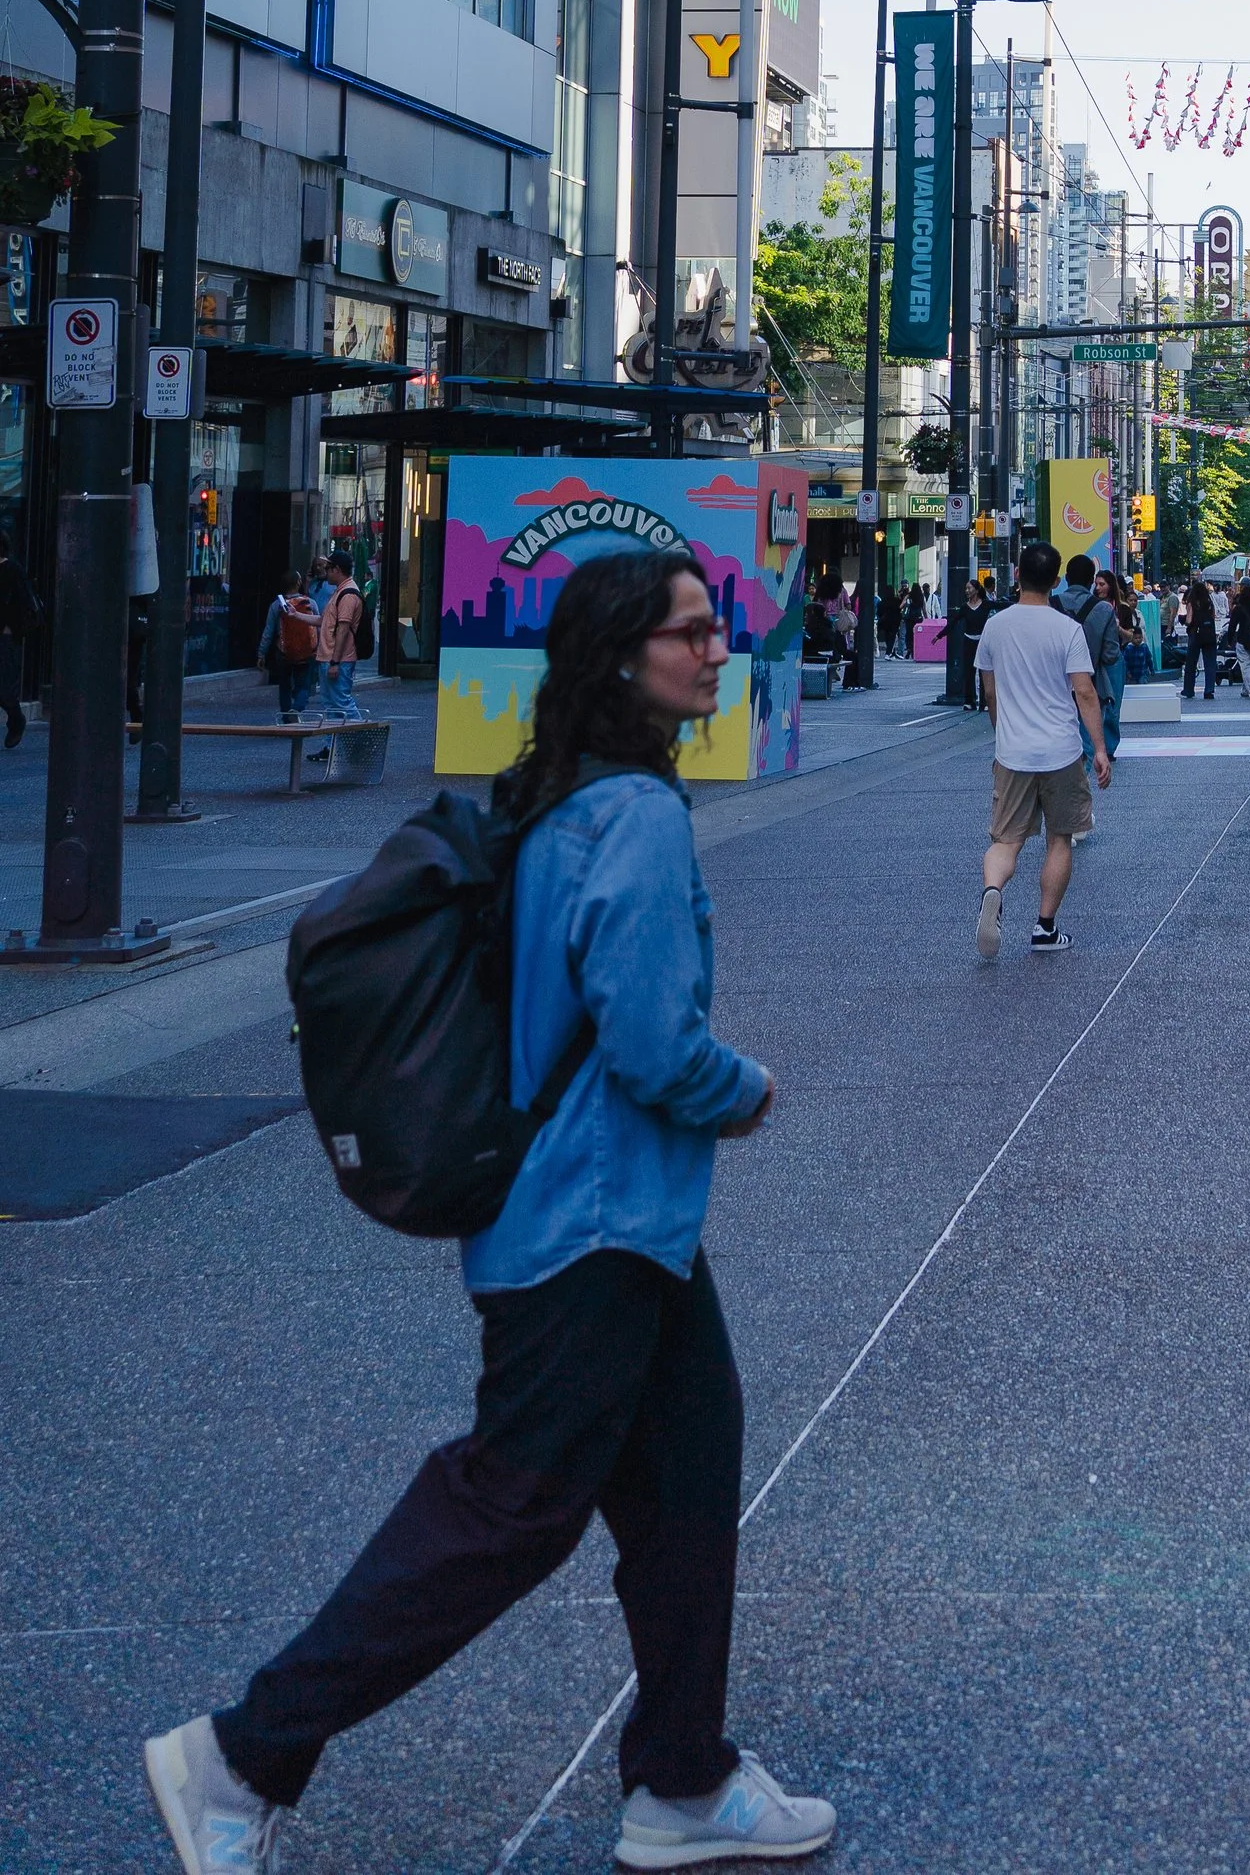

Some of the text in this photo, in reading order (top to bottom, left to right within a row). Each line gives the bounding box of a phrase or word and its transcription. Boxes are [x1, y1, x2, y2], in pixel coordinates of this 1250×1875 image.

[914, 43, 936, 91] WE
[909, 164, 935, 323] VANCOUVER
[498, 256, 541, 285] THE NORTH FACE
[64, 353, 95, 362] DO NO
[1084, 346, 1147, 359] Robson St
[67, 363, 96, 371] BLOCK
[69, 374, 90, 382] VENT
[912, 503, 945, 514] Lenno
[771, 491, 799, 545] Canada
